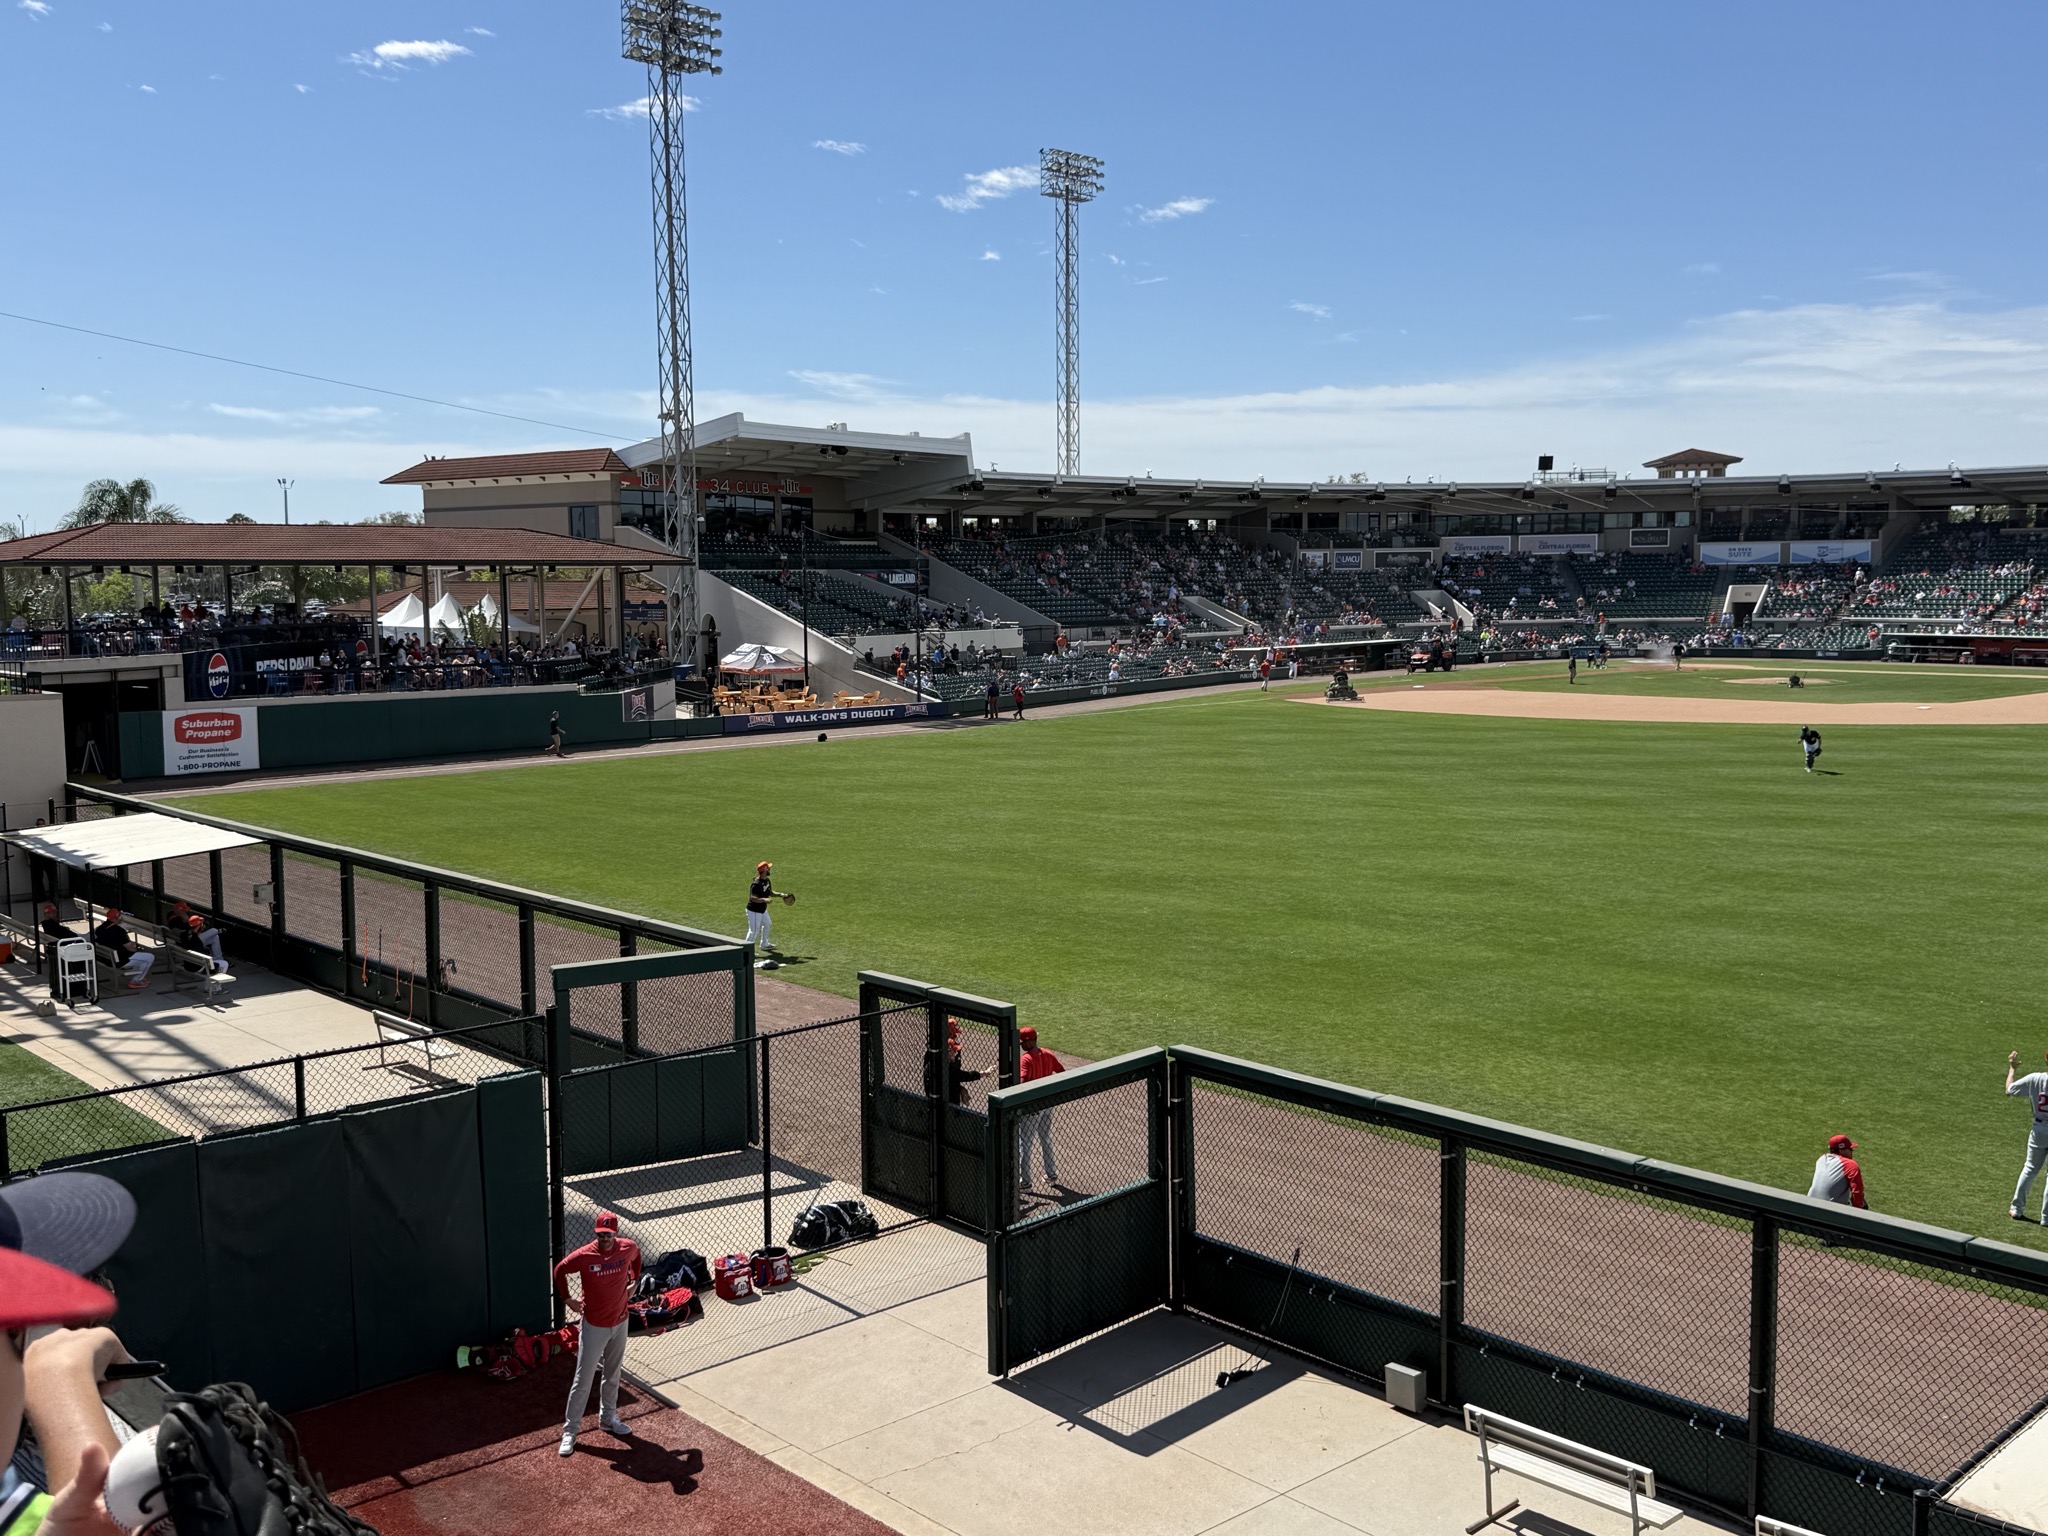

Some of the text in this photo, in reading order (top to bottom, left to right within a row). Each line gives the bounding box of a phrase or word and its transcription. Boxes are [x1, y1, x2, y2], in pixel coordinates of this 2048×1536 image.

[640, 470, 660, 489] Lite
[736, 481, 770, 494] CLUB
[784, 479, 800, 496] Lite
[1342, 555, 1360, 563] LMCU
[889, 573, 916, 584] LAKELAND
[785, 712, 848, 723] WALK-ON'S
[851, 709, 895, 719] DUGOUT
[181, 718, 235, 729] Suburban
[185, 729, 232, 739] Propane
[177, 760, 242, 771] 1-800-PROPANE
[597, 1267, 622, 1276] BASEBALL
